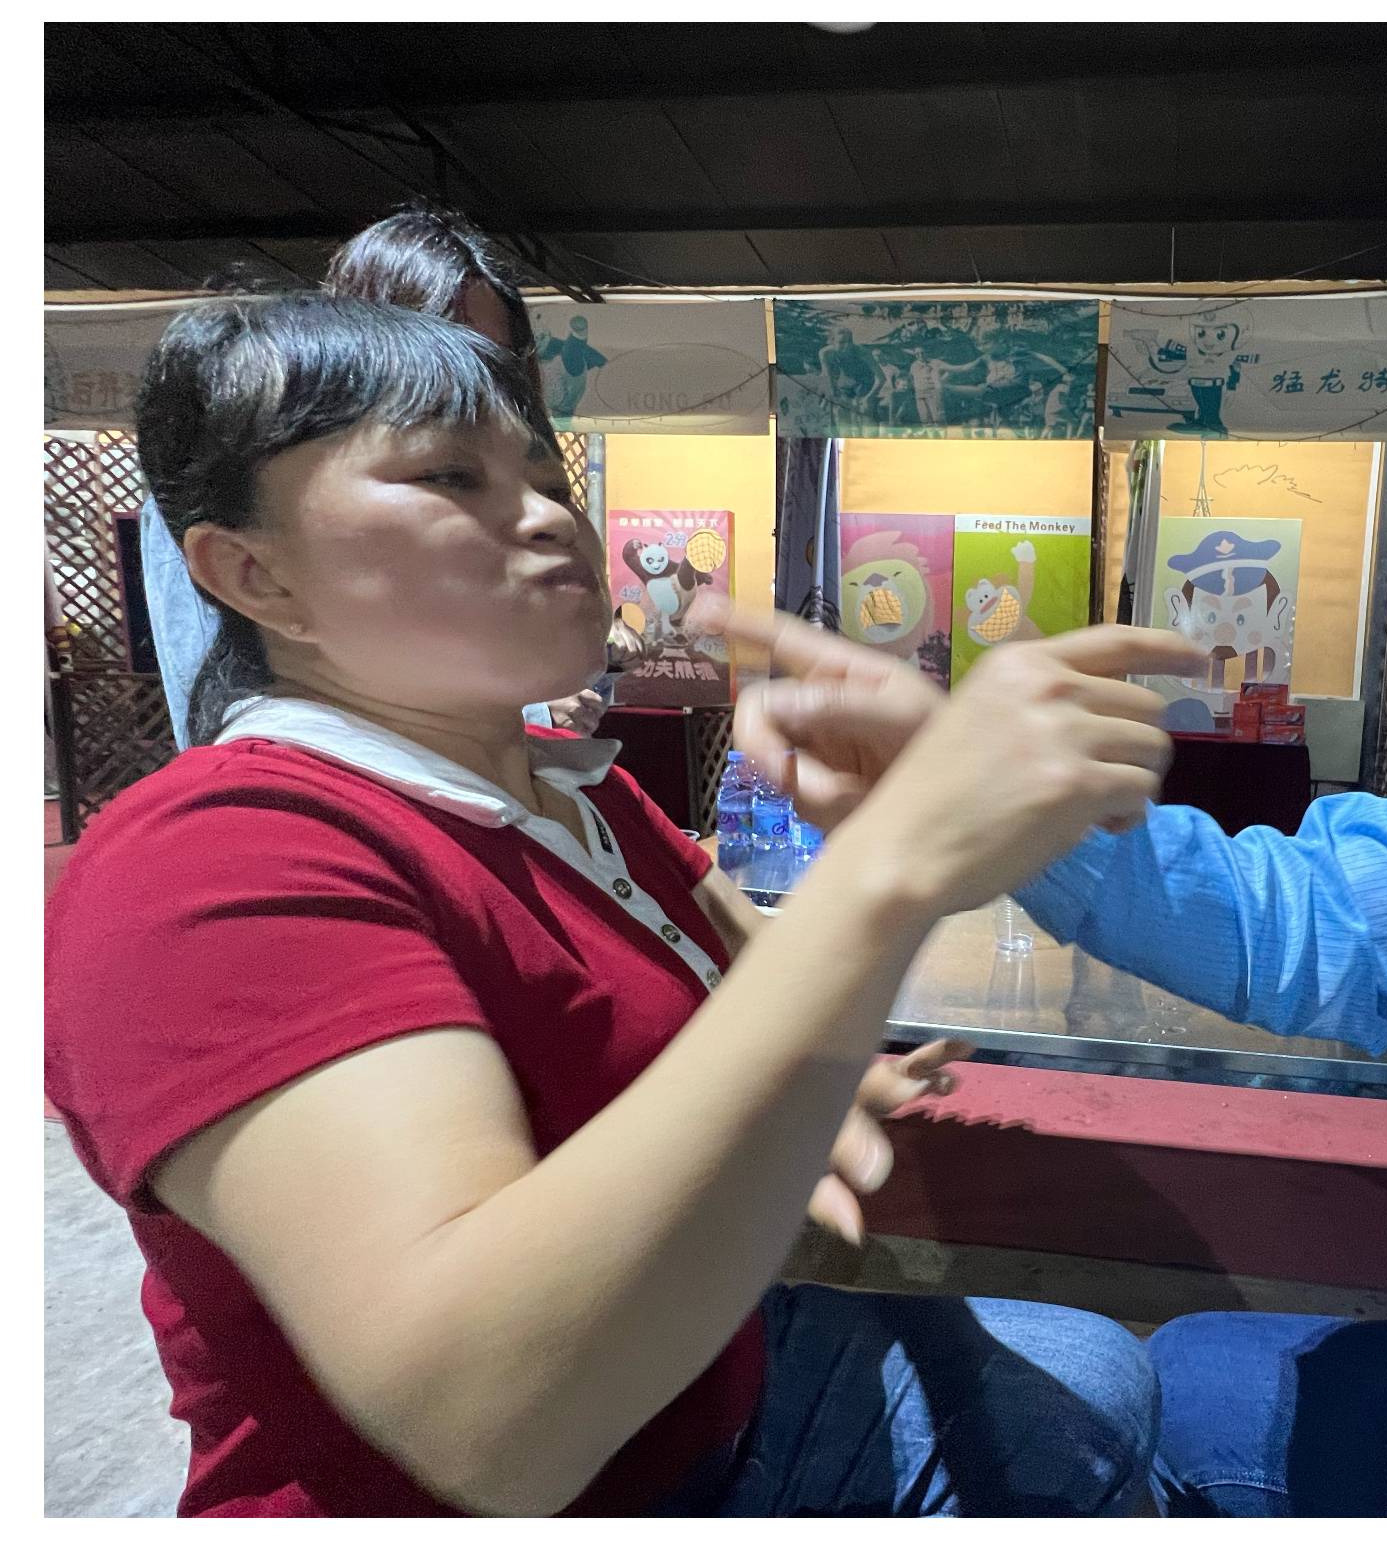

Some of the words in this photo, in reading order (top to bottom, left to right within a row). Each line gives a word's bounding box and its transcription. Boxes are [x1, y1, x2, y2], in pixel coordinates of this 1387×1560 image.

[626, 391, 689, 410] KONG
[975, 520, 1001, 530] Feed
[1006, 520, 1026, 531] The
[1029, 521, 1075, 533] Monkey
